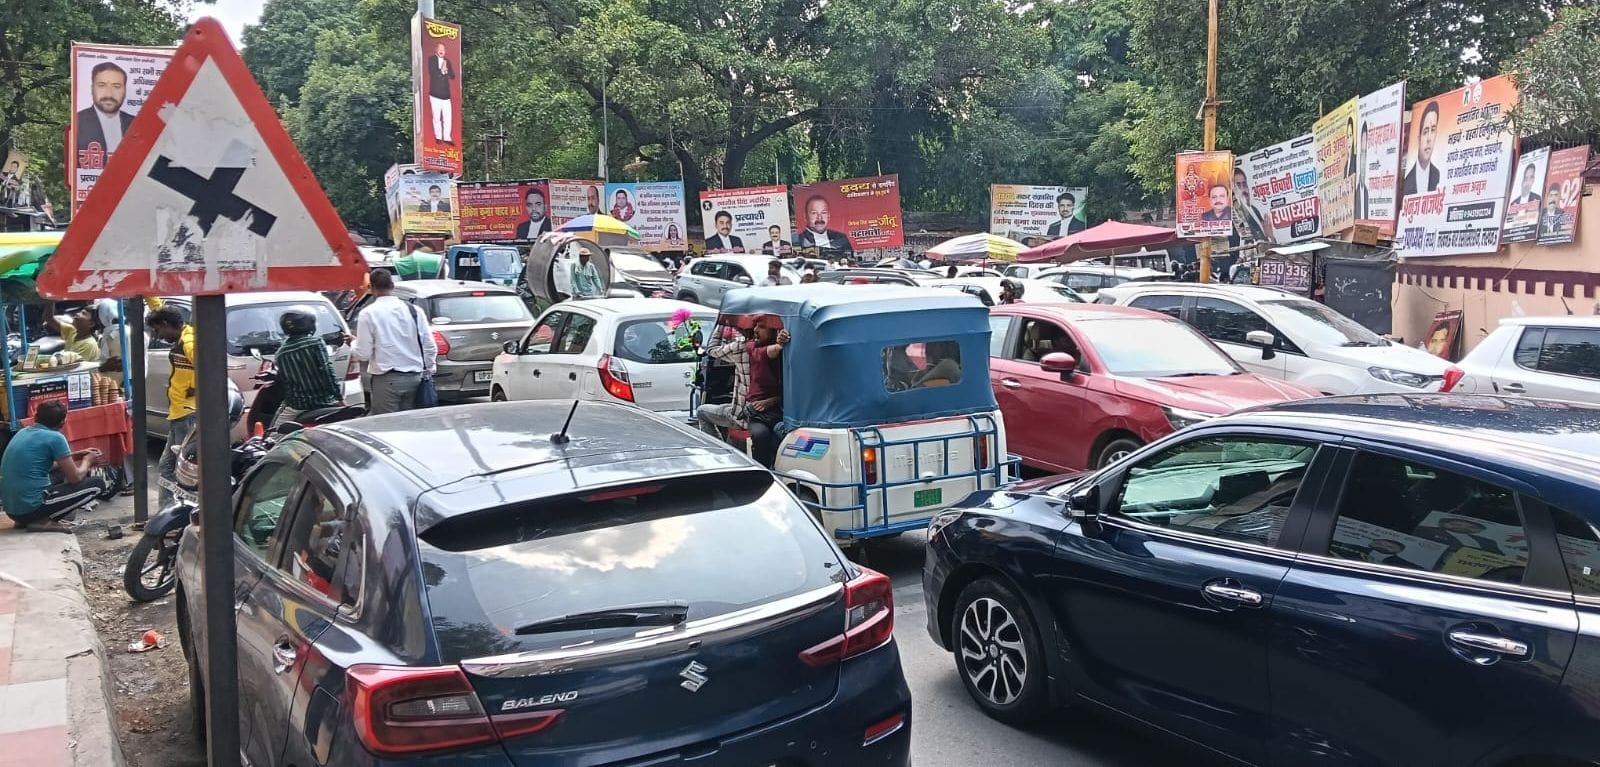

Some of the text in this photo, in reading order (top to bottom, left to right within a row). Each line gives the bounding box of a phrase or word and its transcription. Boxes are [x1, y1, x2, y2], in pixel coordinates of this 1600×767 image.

[79, 141, 104, 169] रवि
[1559, 177, 1580, 209] 92
[734, 210, 765, 222] प्रत्याशी
[1272, 197, 1317, 224] उपाध्यक्ष
[1263, 263, 1284, 275] 330
[501, 690, 579, 711] BALENO
